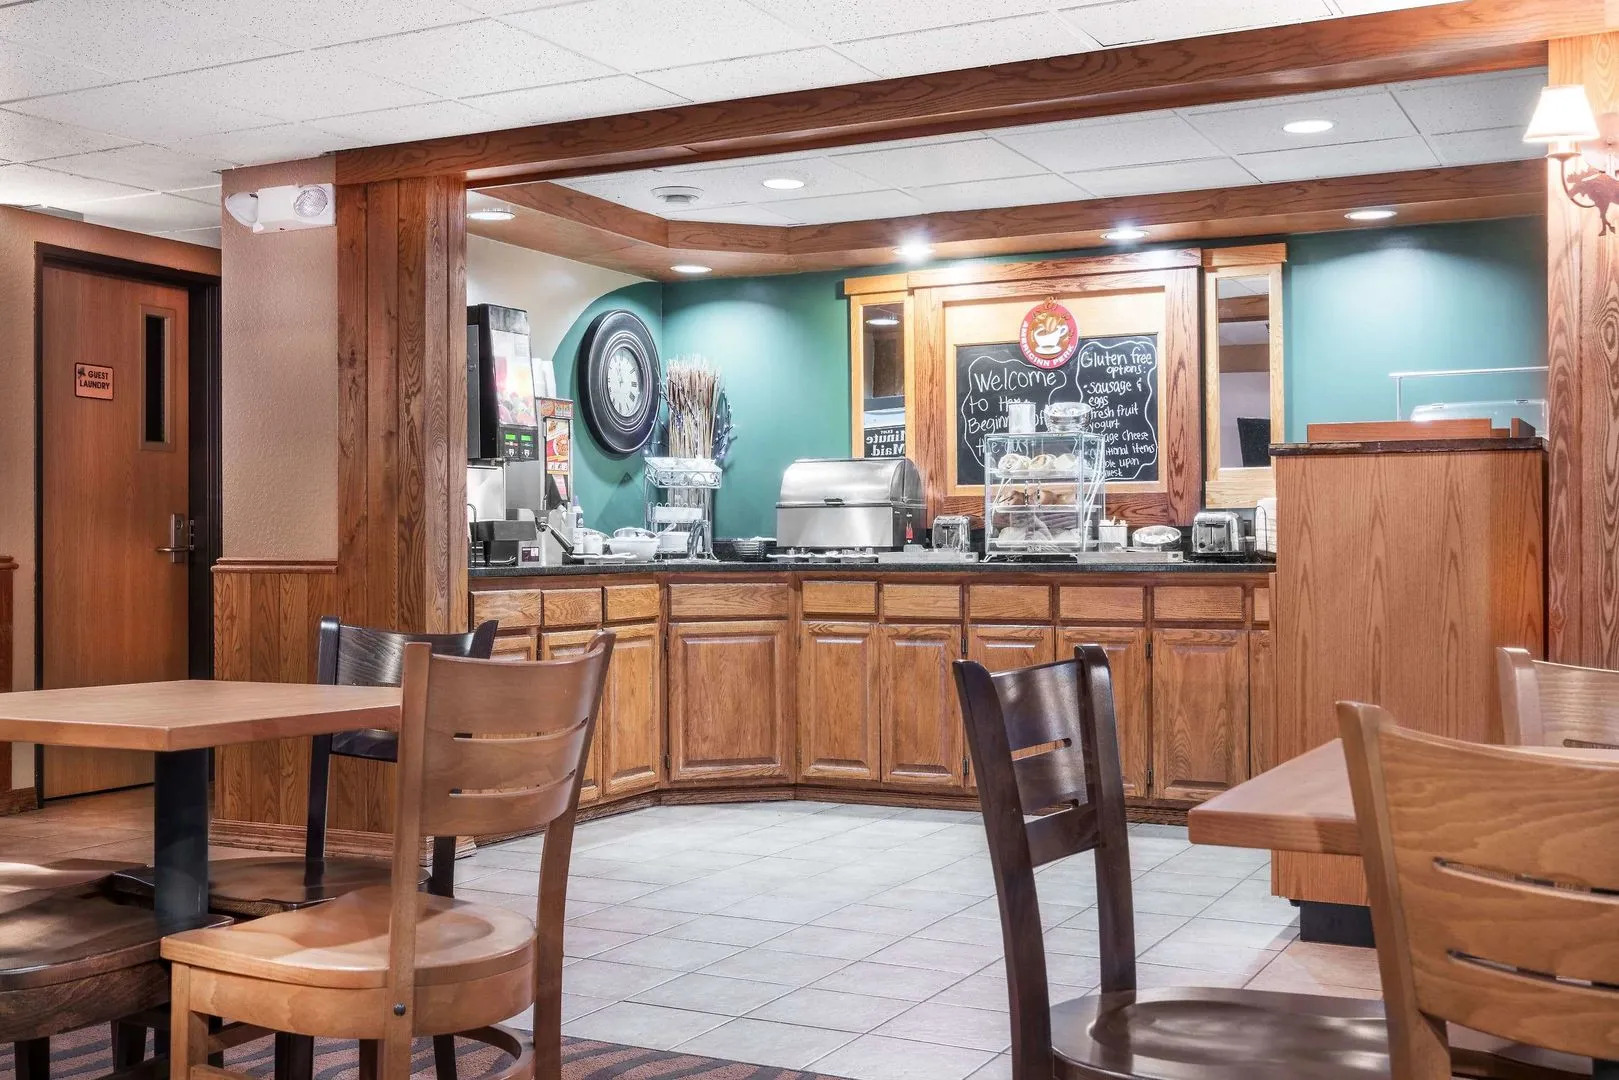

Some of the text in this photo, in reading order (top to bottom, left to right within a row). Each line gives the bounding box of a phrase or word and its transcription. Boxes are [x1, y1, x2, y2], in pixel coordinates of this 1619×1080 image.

[1080, 346, 1153, 368] Gluten free
[88, 371, 109, 380] GUEST
[974, 368, 1057, 392] Welcome
[80, 380, 110, 389] LAUNDRY
[968, 395, 989, 414] to
[1088, 395, 1109, 409] eggs
[1116, 402, 1139, 417] fruit
[1089, 418, 1120, 434] yogurt
